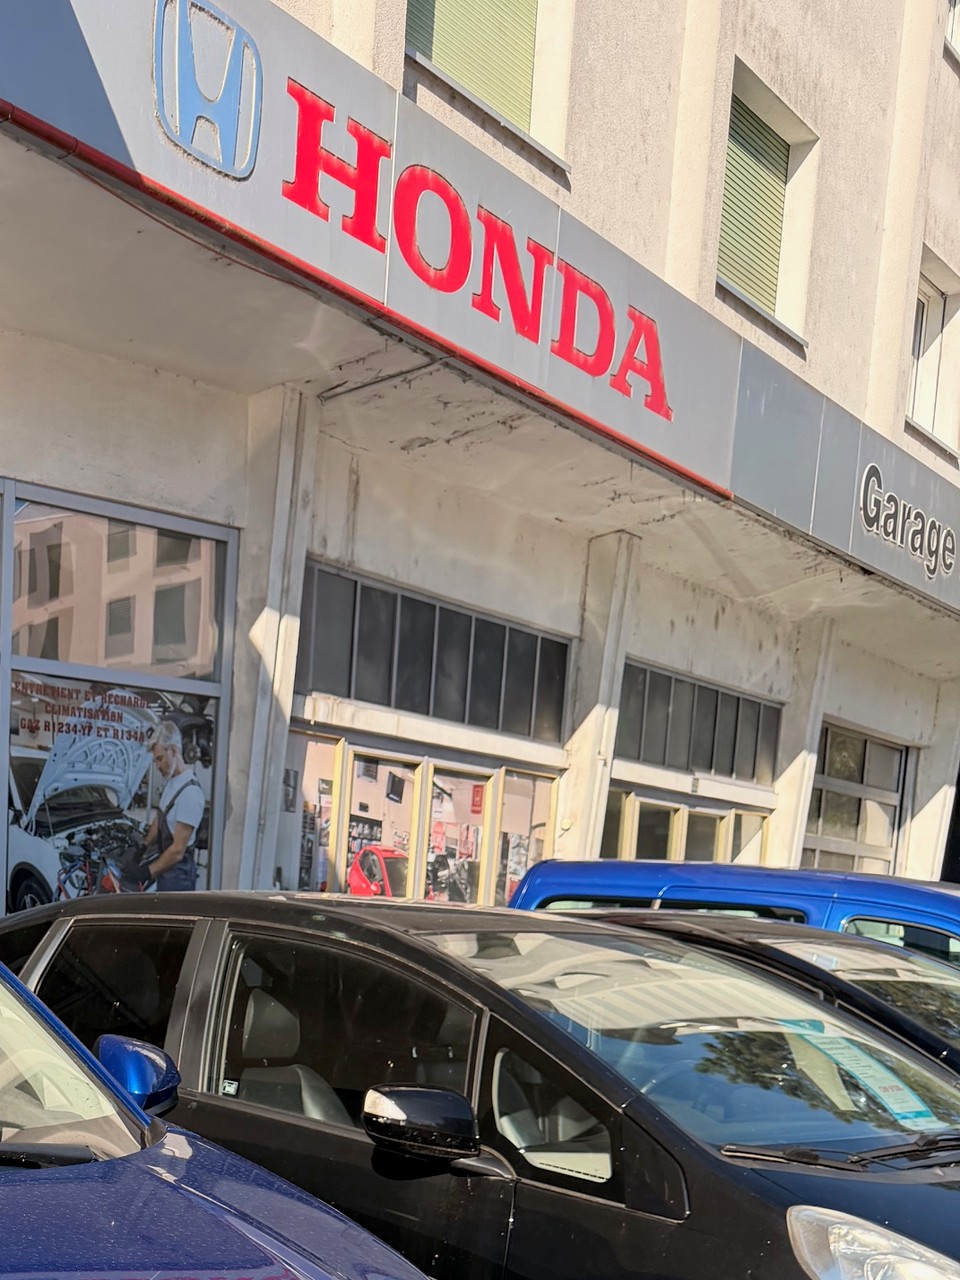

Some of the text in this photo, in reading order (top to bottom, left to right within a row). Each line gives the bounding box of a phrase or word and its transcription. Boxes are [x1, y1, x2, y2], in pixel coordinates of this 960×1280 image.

[282, 77, 674, 423] HONDA
[861, 463, 956, 578] Garage
[20, 718, 40, 731] GAZ
[96, 726, 110, 738] ET
